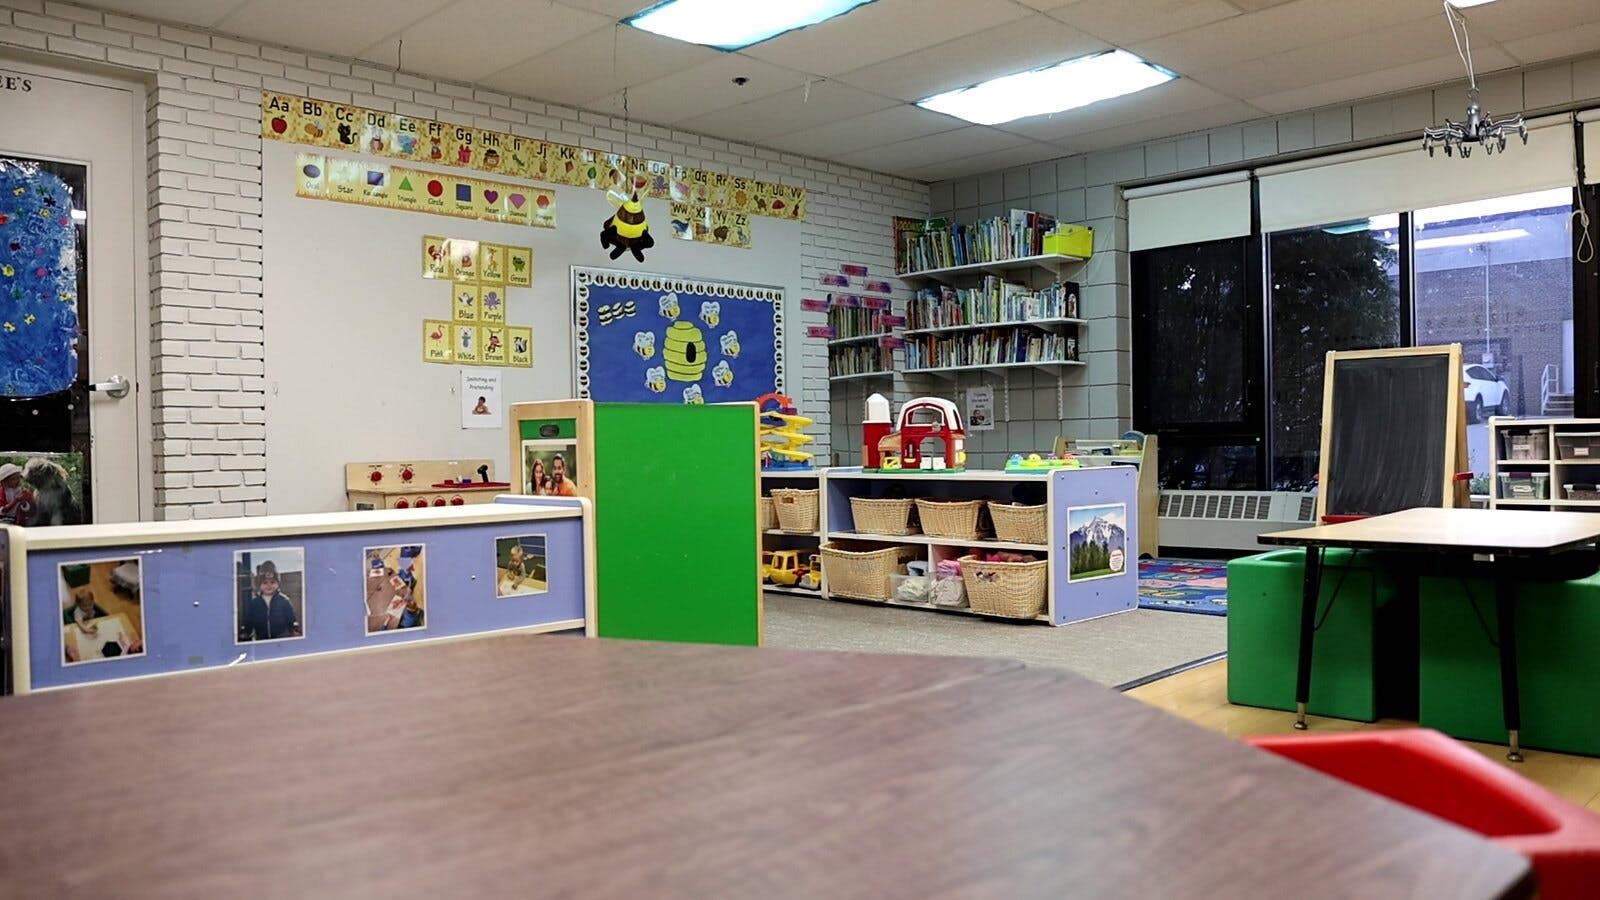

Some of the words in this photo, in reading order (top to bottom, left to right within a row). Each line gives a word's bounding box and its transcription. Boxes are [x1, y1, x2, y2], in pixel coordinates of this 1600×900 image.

[269, 96, 290, 113] Aa
[303, 102, 322, 117] Bb
[335, 109, 353, 123] Cc
[367, 113, 385, 128] Dd
[399, 119, 416, 133] Ee
[429, 123, 442, 136] Ff
[455, 128, 472, 145] Gg
[483, 133, 500, 147] Hh
[513, 138, 521, 151] Ii
[537, 143, 547, 159] Jj
[560, 147, 575, 160] Kk
[586, 151, 597, 163] Ll
[631, 159, 645, 171] Nn
[653, 163, 665, 175] Oo
[675, 167, 687, 180] Pp
[695, 171, 707, 185] Qq
[716, 175, 727, 185] Rr
[735, 179, 745, 190] Ss
[755, 180, 764, 193] Tt
[772, 185, 784, 197] Uu
[791, 187, 801, 199] Vv
[337, 185, 353, 194] Star
[672, 204, 688, 215] Ww
[716, 211, 727, 224] Yy
[735, 214, 746, 226] Zz
[483, 270, 501, 279] Yellow
[510, 274, 528, 284] Green
[458, 310, 474, 320] Blue
[483, 312, 502, 324] Purple
[457, 352, 476, 361] White
[485, 353, 503, 361] Brown
[513, 355, 528, 364] Black
